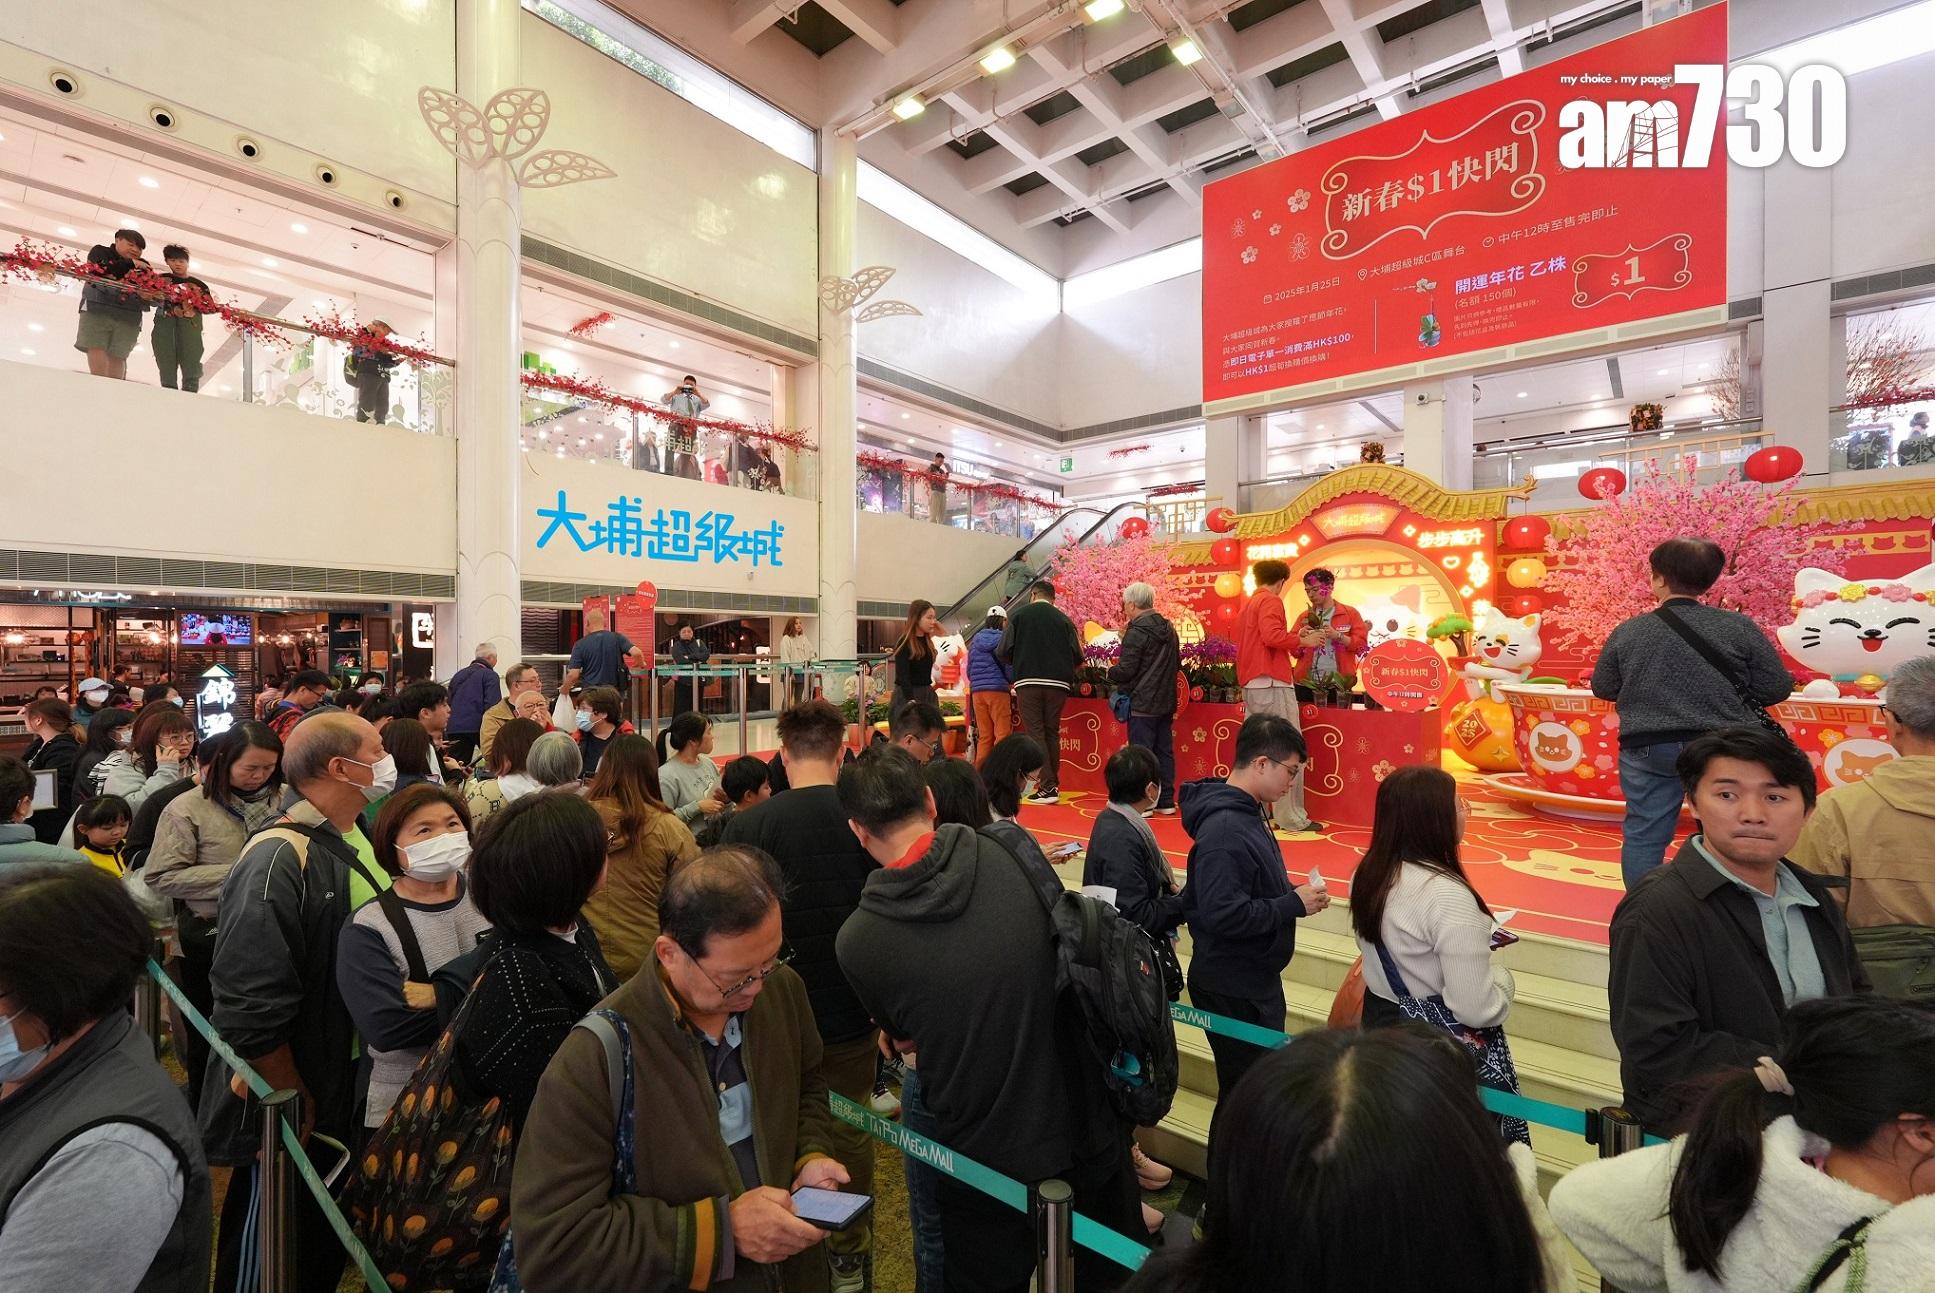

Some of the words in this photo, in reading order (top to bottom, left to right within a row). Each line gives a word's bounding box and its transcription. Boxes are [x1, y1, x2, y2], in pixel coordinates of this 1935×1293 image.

[1342, 142, 1519, 222] 新春$1快閃
[1498, 205, 1619, 244] 中午12時至售完即止
[1275, 277, 1340, 301] 2025年1月25日
[1455, 265, 1525, 295] 開運年花
[1530, 255, 1567, 277] 乙株
[1610, 255, 1646, 287] $1
[536, 489, 785, 567] 大埔超級城
